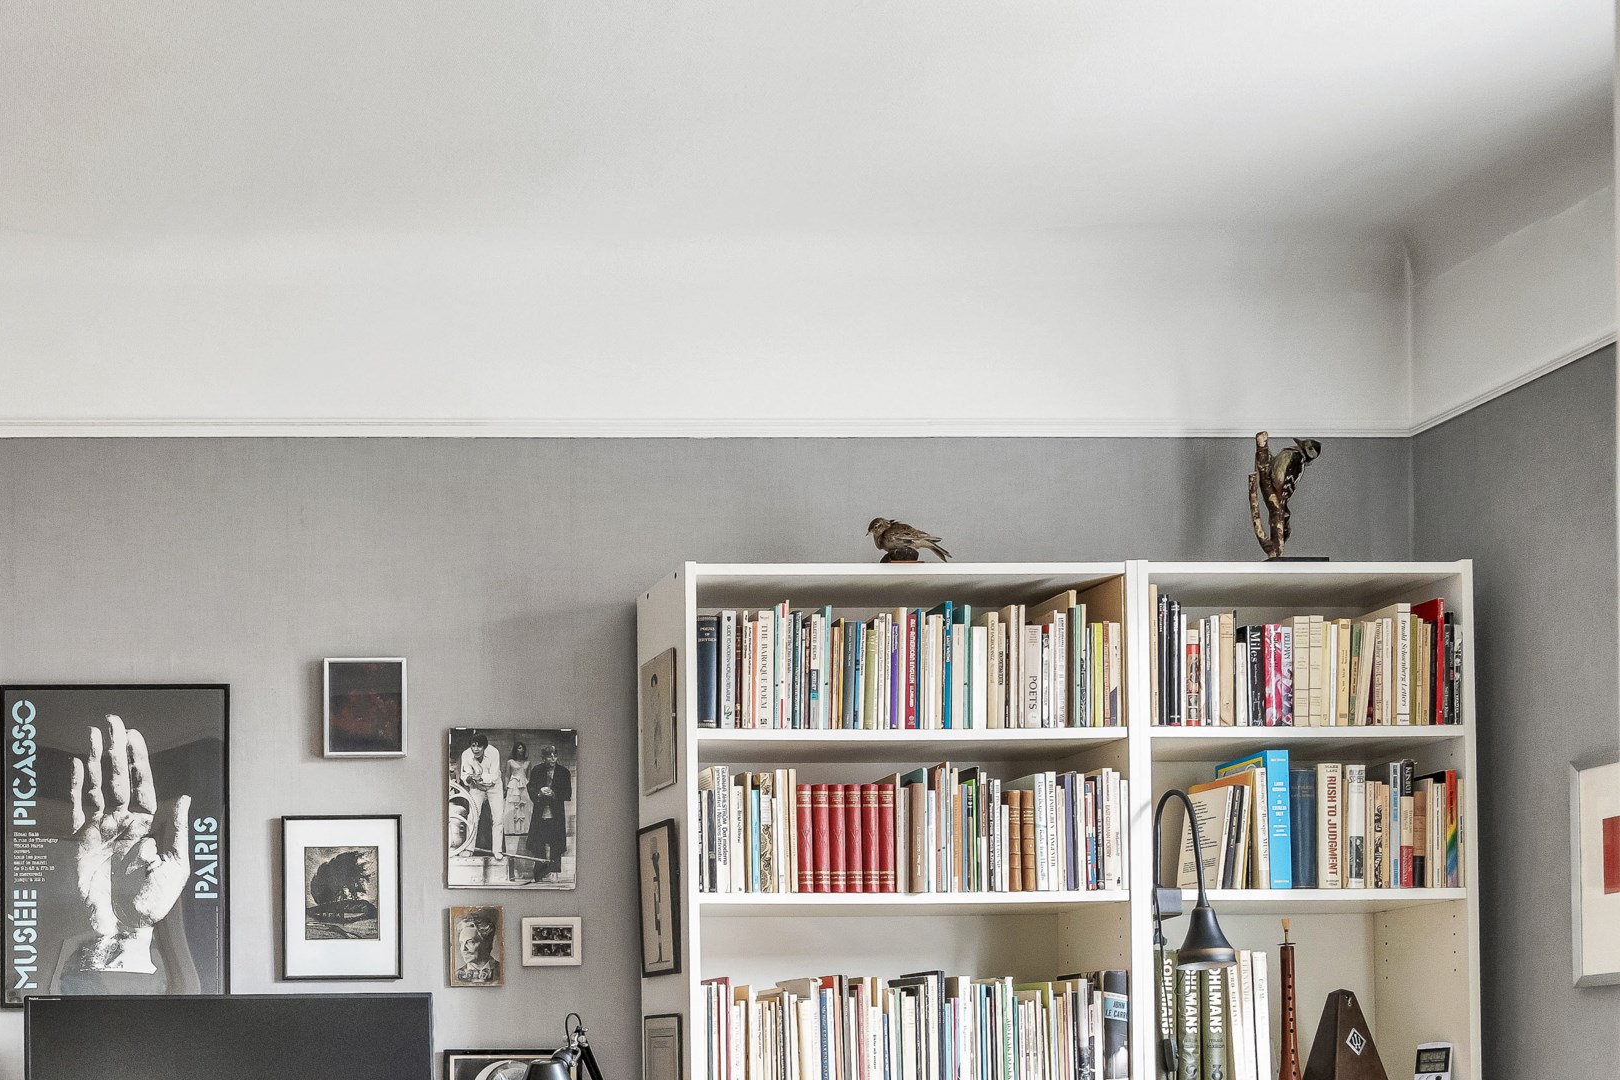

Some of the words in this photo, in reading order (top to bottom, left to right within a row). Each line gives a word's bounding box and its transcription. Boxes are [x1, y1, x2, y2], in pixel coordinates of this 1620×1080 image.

[760, 623, 769, 642] THE
[1250, 631, 1261, 663] Miles
[760, 643, 769, 684] BAROQUE
[760, 685, 769, 709] POEM
[1028, 675, 1038, 710] POETS
[12, 700, 37, 825] PICASSO
[1327, 775, 1337, 803] RUSH
[1327, 804, 1337, 817] TO
[194, 817, 218, 899] PARIS
[1327, 819, 1338, 876] JUDGMENT
[8, 890, 37, 989] MUSÉE
[1184, 966, 1197, 1034] OHLMANS
[1208, 966, 1222, 1034] OHLMANS
